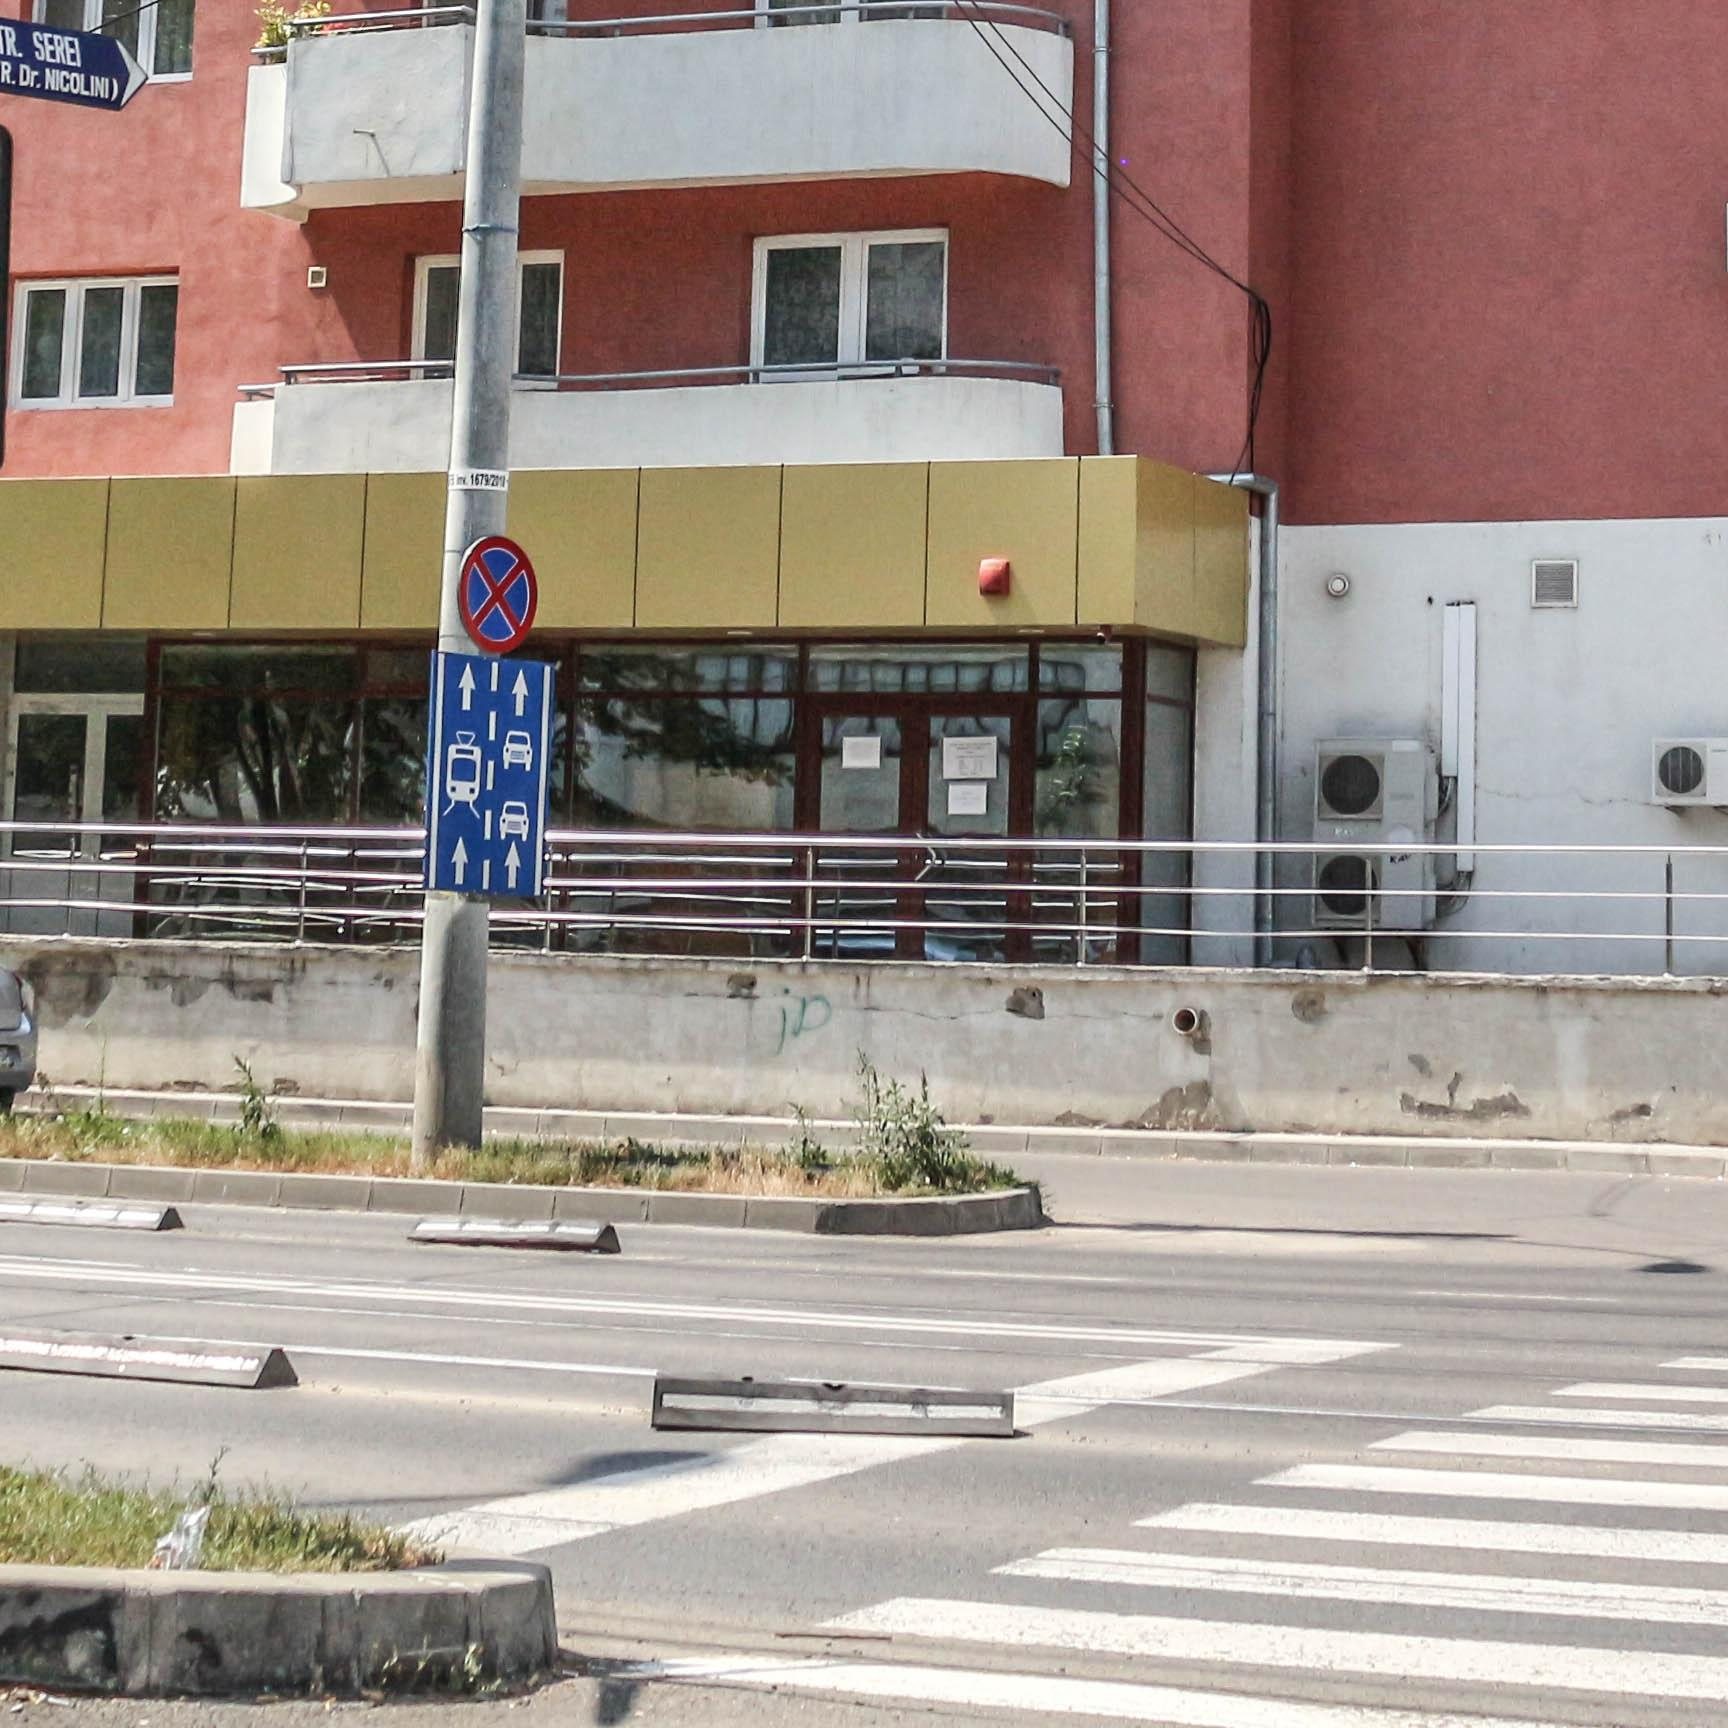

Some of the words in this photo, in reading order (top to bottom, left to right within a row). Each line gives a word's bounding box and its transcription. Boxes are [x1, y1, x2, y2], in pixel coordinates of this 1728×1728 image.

[32, 31, 82, 68] SEREI
[19, 66, 42, 89] Dr.
[44, 68, 119, 102] NICOLINI)
